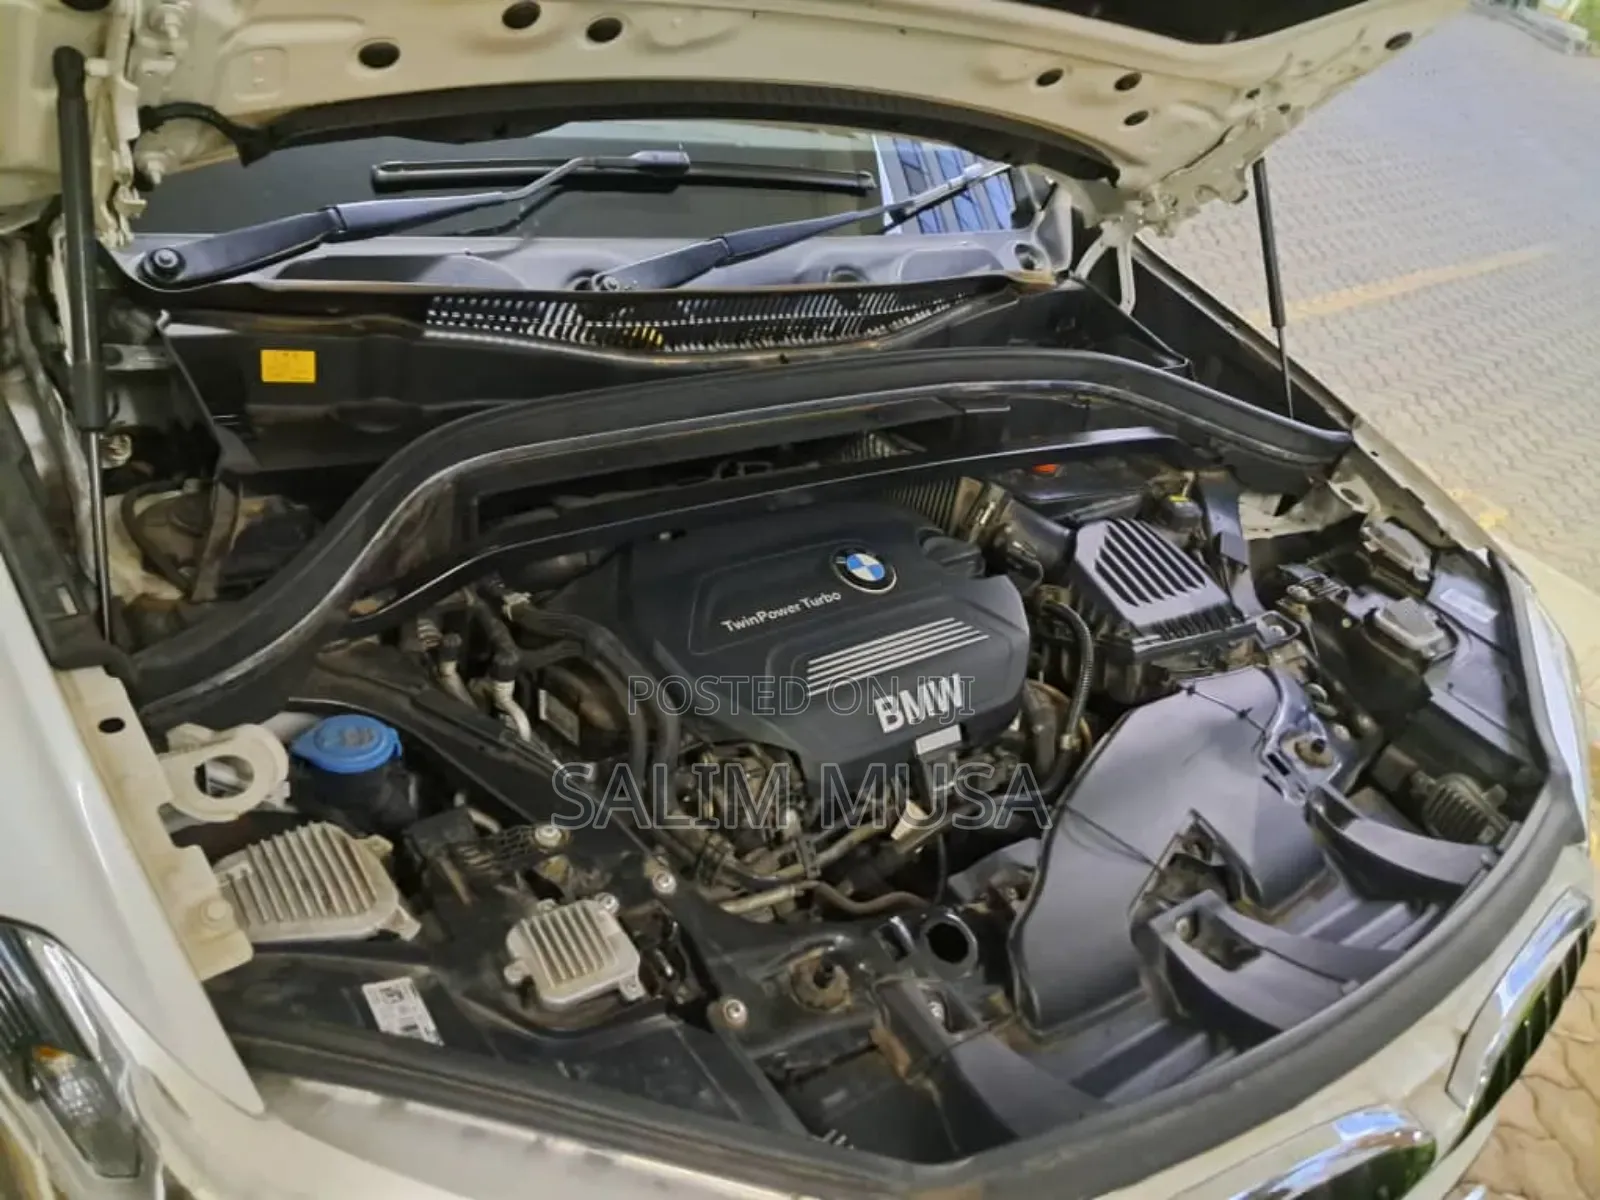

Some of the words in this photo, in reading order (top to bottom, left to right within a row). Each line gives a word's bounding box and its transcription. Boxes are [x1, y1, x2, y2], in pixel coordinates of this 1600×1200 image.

[720, 602, 801, 632] TwinPower
[800, 591, 842, 610] Turbo
[874, 673, 963, 733] BMW
